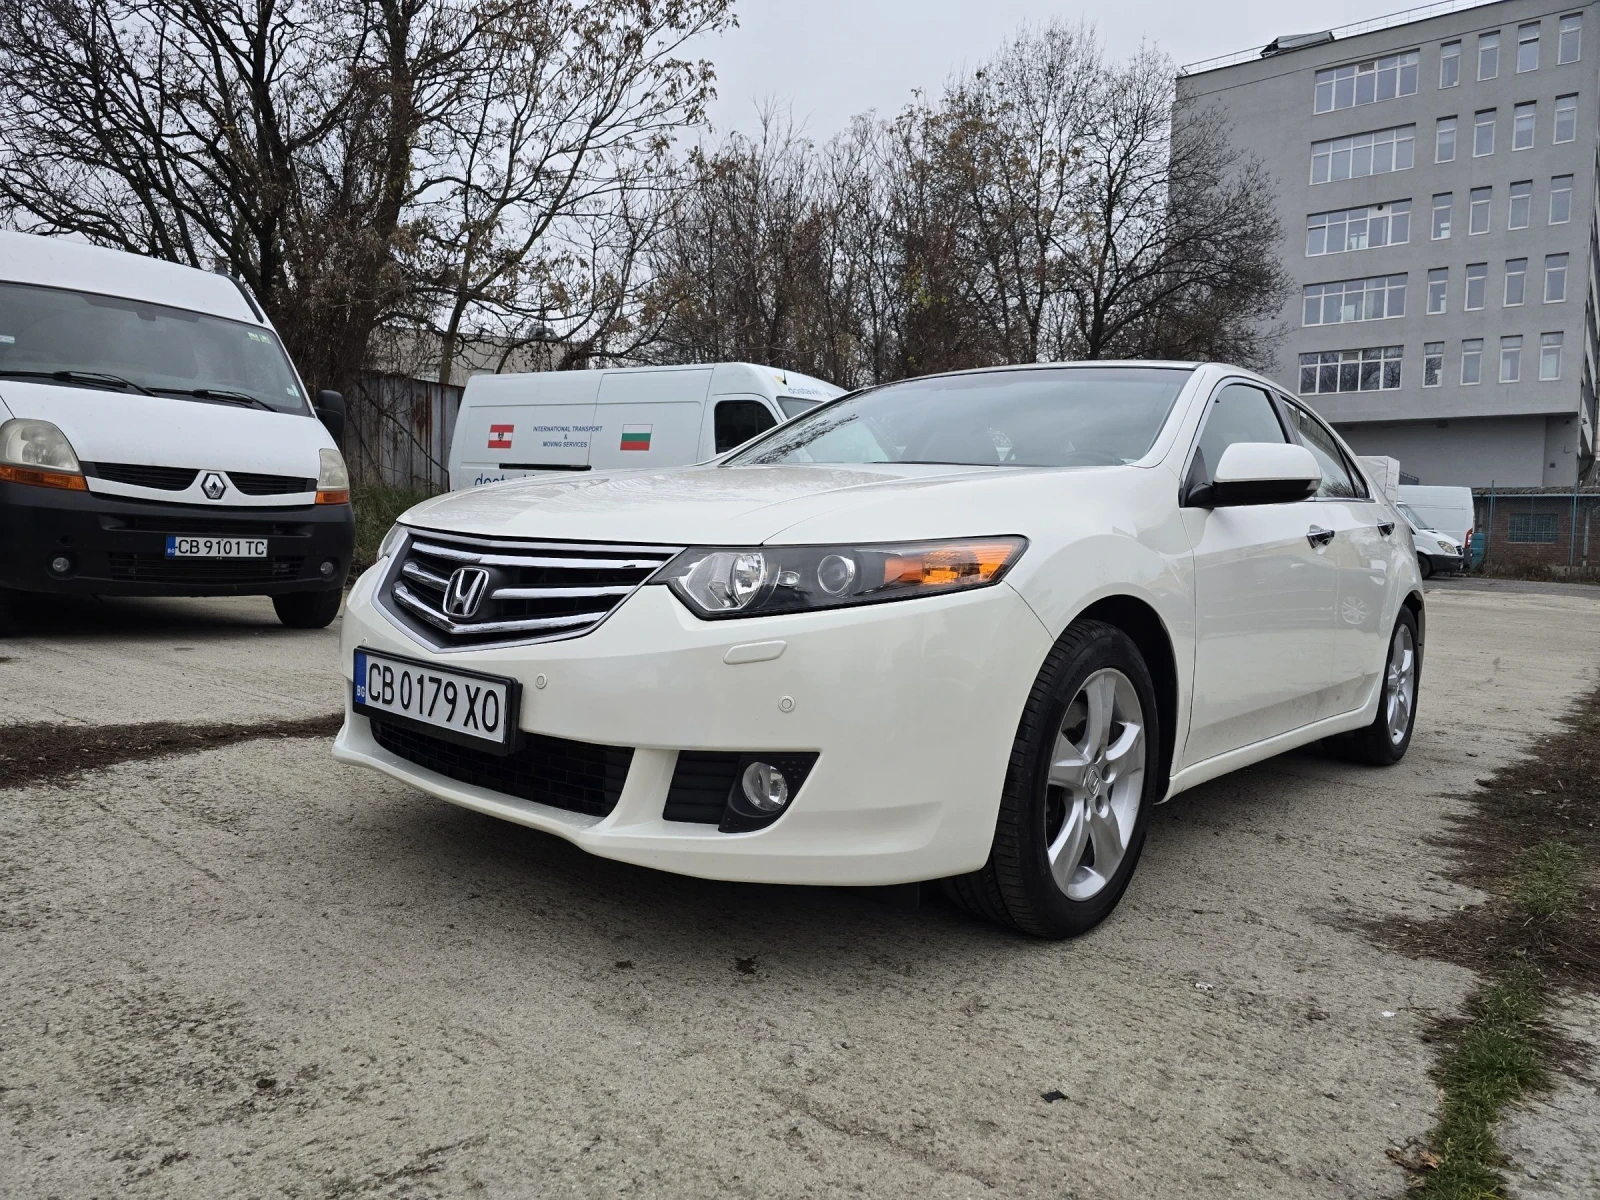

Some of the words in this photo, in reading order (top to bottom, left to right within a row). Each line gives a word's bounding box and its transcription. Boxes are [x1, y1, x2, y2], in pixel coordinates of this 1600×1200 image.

[533, 425, 571, 433] INTERNATIONAL
[178, 539, 200, 555] CB
[203, 540, 240, 555] 9101
[246, 541, 265, 556] TC
[356, 685, 366, 698] BG
[368, 663, 395, 705] CB
[400, 670, 458, 722] 0179
